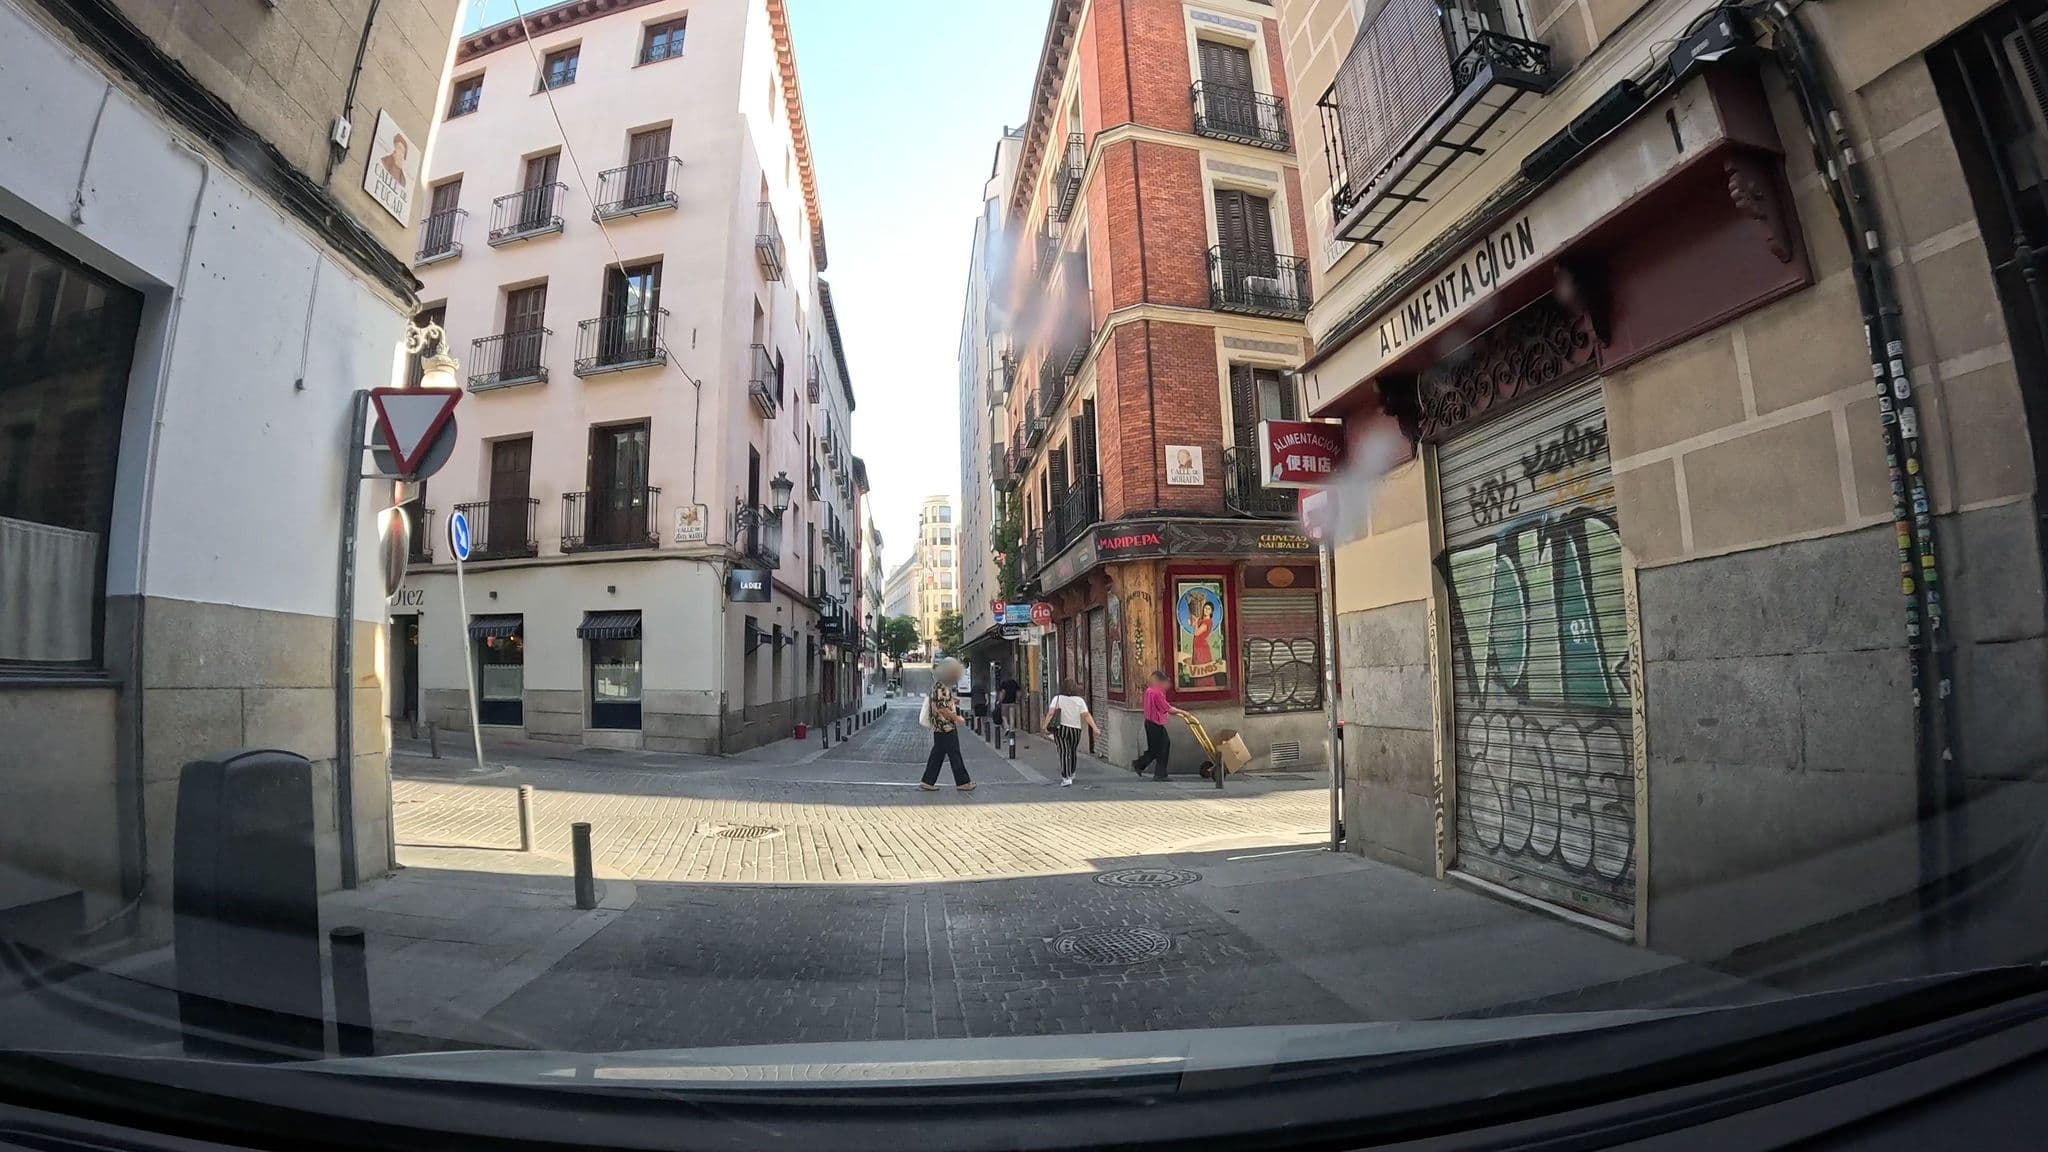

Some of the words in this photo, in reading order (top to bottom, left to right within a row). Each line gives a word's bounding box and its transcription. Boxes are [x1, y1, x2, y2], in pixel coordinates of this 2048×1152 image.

[374, 163, 400, 195] CALLE
[374, 180, 404, 217] FUCAR
[1379, 216, 1535, 358] ALIMENTACION
[1286, 454, 1331, 473] 便利店
[1097, 533, 1160, 550] MARIPEPA
[1260, 534, 1307, 542] CERVEZAS
[740, 582, 748, 590] LA
[749, 582, 762, 590] DIEZ
[1033, 605, 1051, 618] ria
[1188, 662, 1218, 676] VINOS
